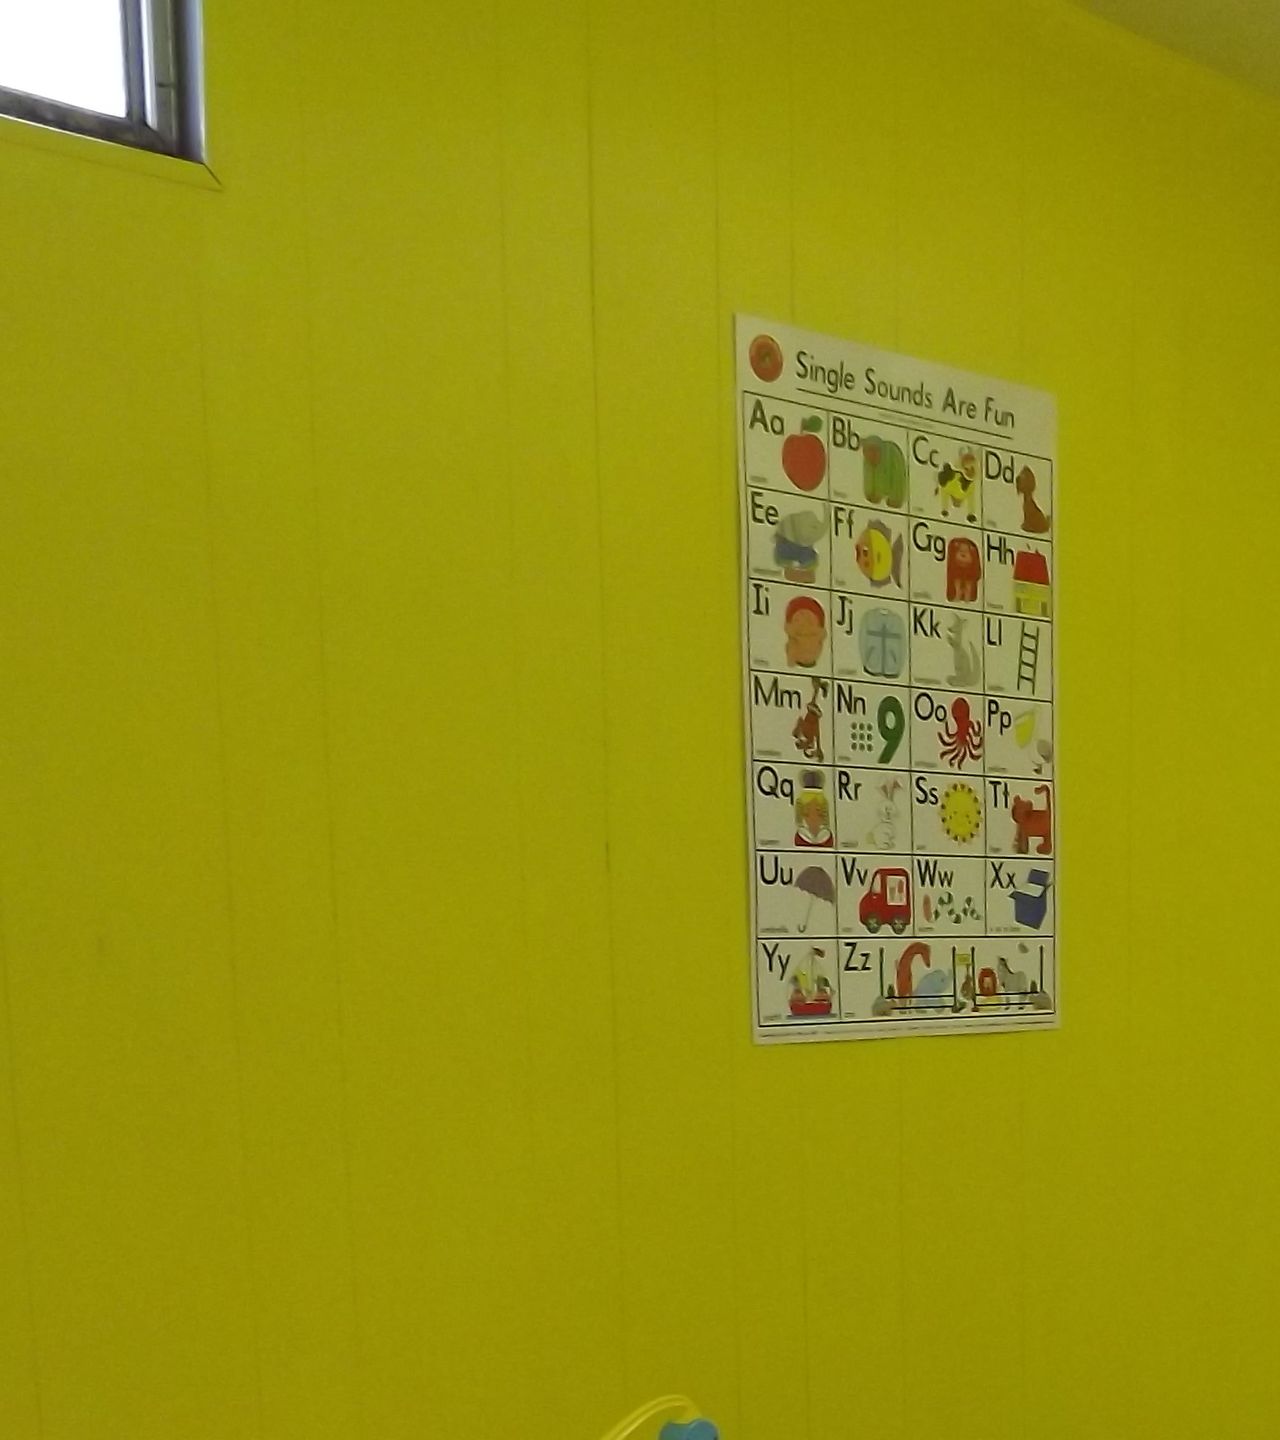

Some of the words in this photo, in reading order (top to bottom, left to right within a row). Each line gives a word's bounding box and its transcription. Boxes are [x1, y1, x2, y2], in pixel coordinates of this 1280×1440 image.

[796, 350, 855, 393] Single
[864, 367, 933, 410] Sounds
[942, 387, 976, 419] Are
[984, 397, 1015, 428] Fun
[749, 399, 784, 435] Aa
[832, 416, 860, 451] Bb
[912, 436, 939, 468] Cc
[985, 452, 1015, 484] Dd
[751, 492, 779, 526] Ee
[834, 507, 855, 539] Ff
[913, 522, 946, 562] Gg
[986, 535, 1015, 565] Hh
[752, 584, 770, 616] Ii
[837, 597, 853, 635] Jj
[913, 609, 942, 639] Kk
[986, 618, 1002, 646] Ll
[754, 676, 801, 708] Mm
[837, 685, 866, 715] Nn
[914, 692, 947, 723] Oo
[877, 696, 905, 764] 9
[987, 700, 1012, 735] Pp
[757, 766, 794, 806] Qq
[839, 770, 862, 801] Rr
[915, 777, 938, 806] Ss
[989, 782, 1009, 809] Tt
[760, 856, 793, 886] Uu
[841, 858, 868, 886] Vv
[917, 859, 954, 889] Ww
[990, 862, 1016, 889] Xx
[761, 943, 789, 981] Yy
[844, 942, 872, 972] Zz
